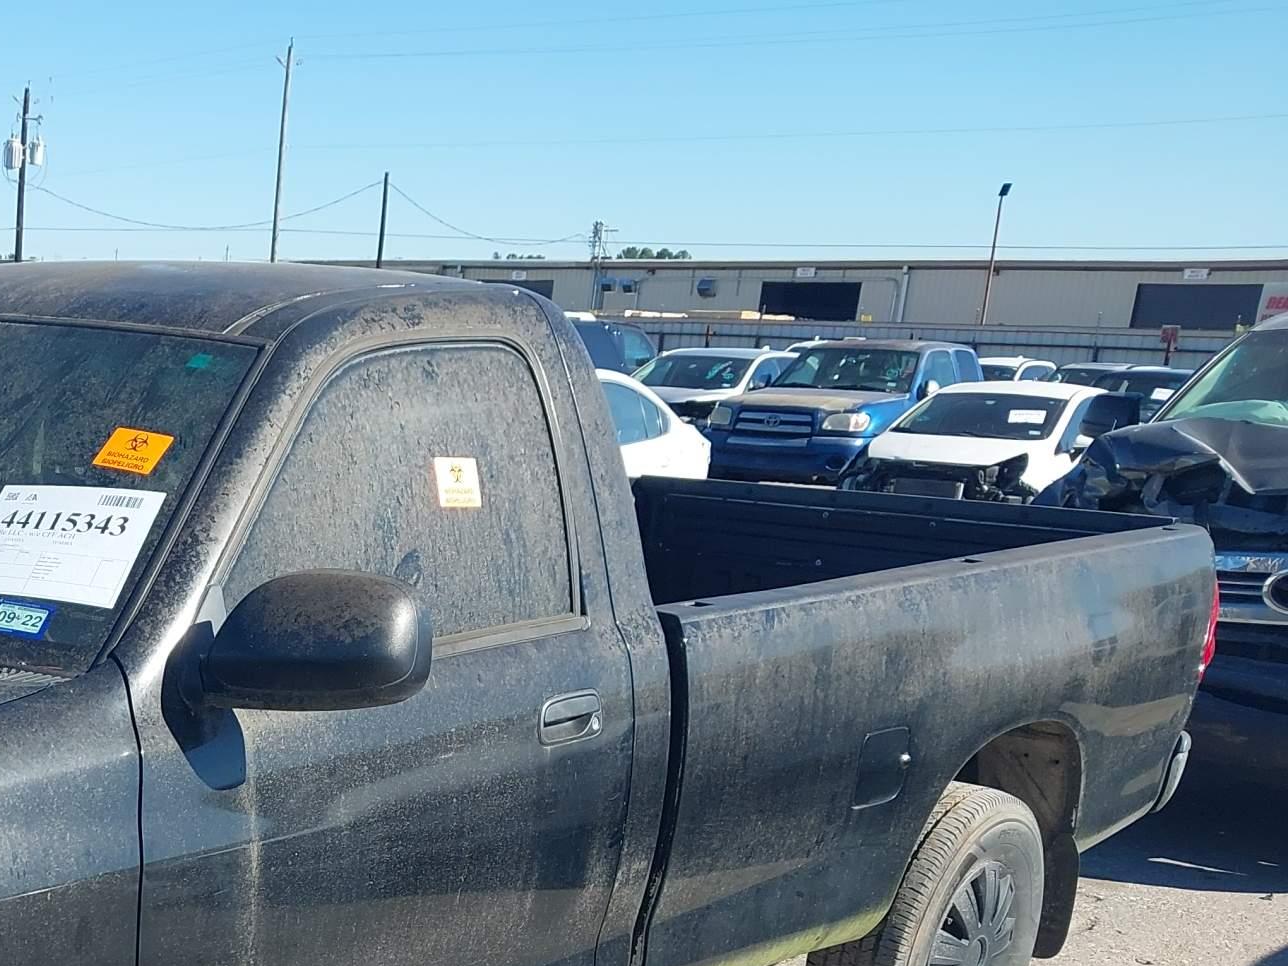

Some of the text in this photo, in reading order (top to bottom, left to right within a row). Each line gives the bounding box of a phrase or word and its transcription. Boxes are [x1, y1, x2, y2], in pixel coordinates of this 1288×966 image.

[107, 451, 149, 463] BIOHAZARD
[0, 509, 130, 537] 44115343
[21, 614, 43, 628] 22
